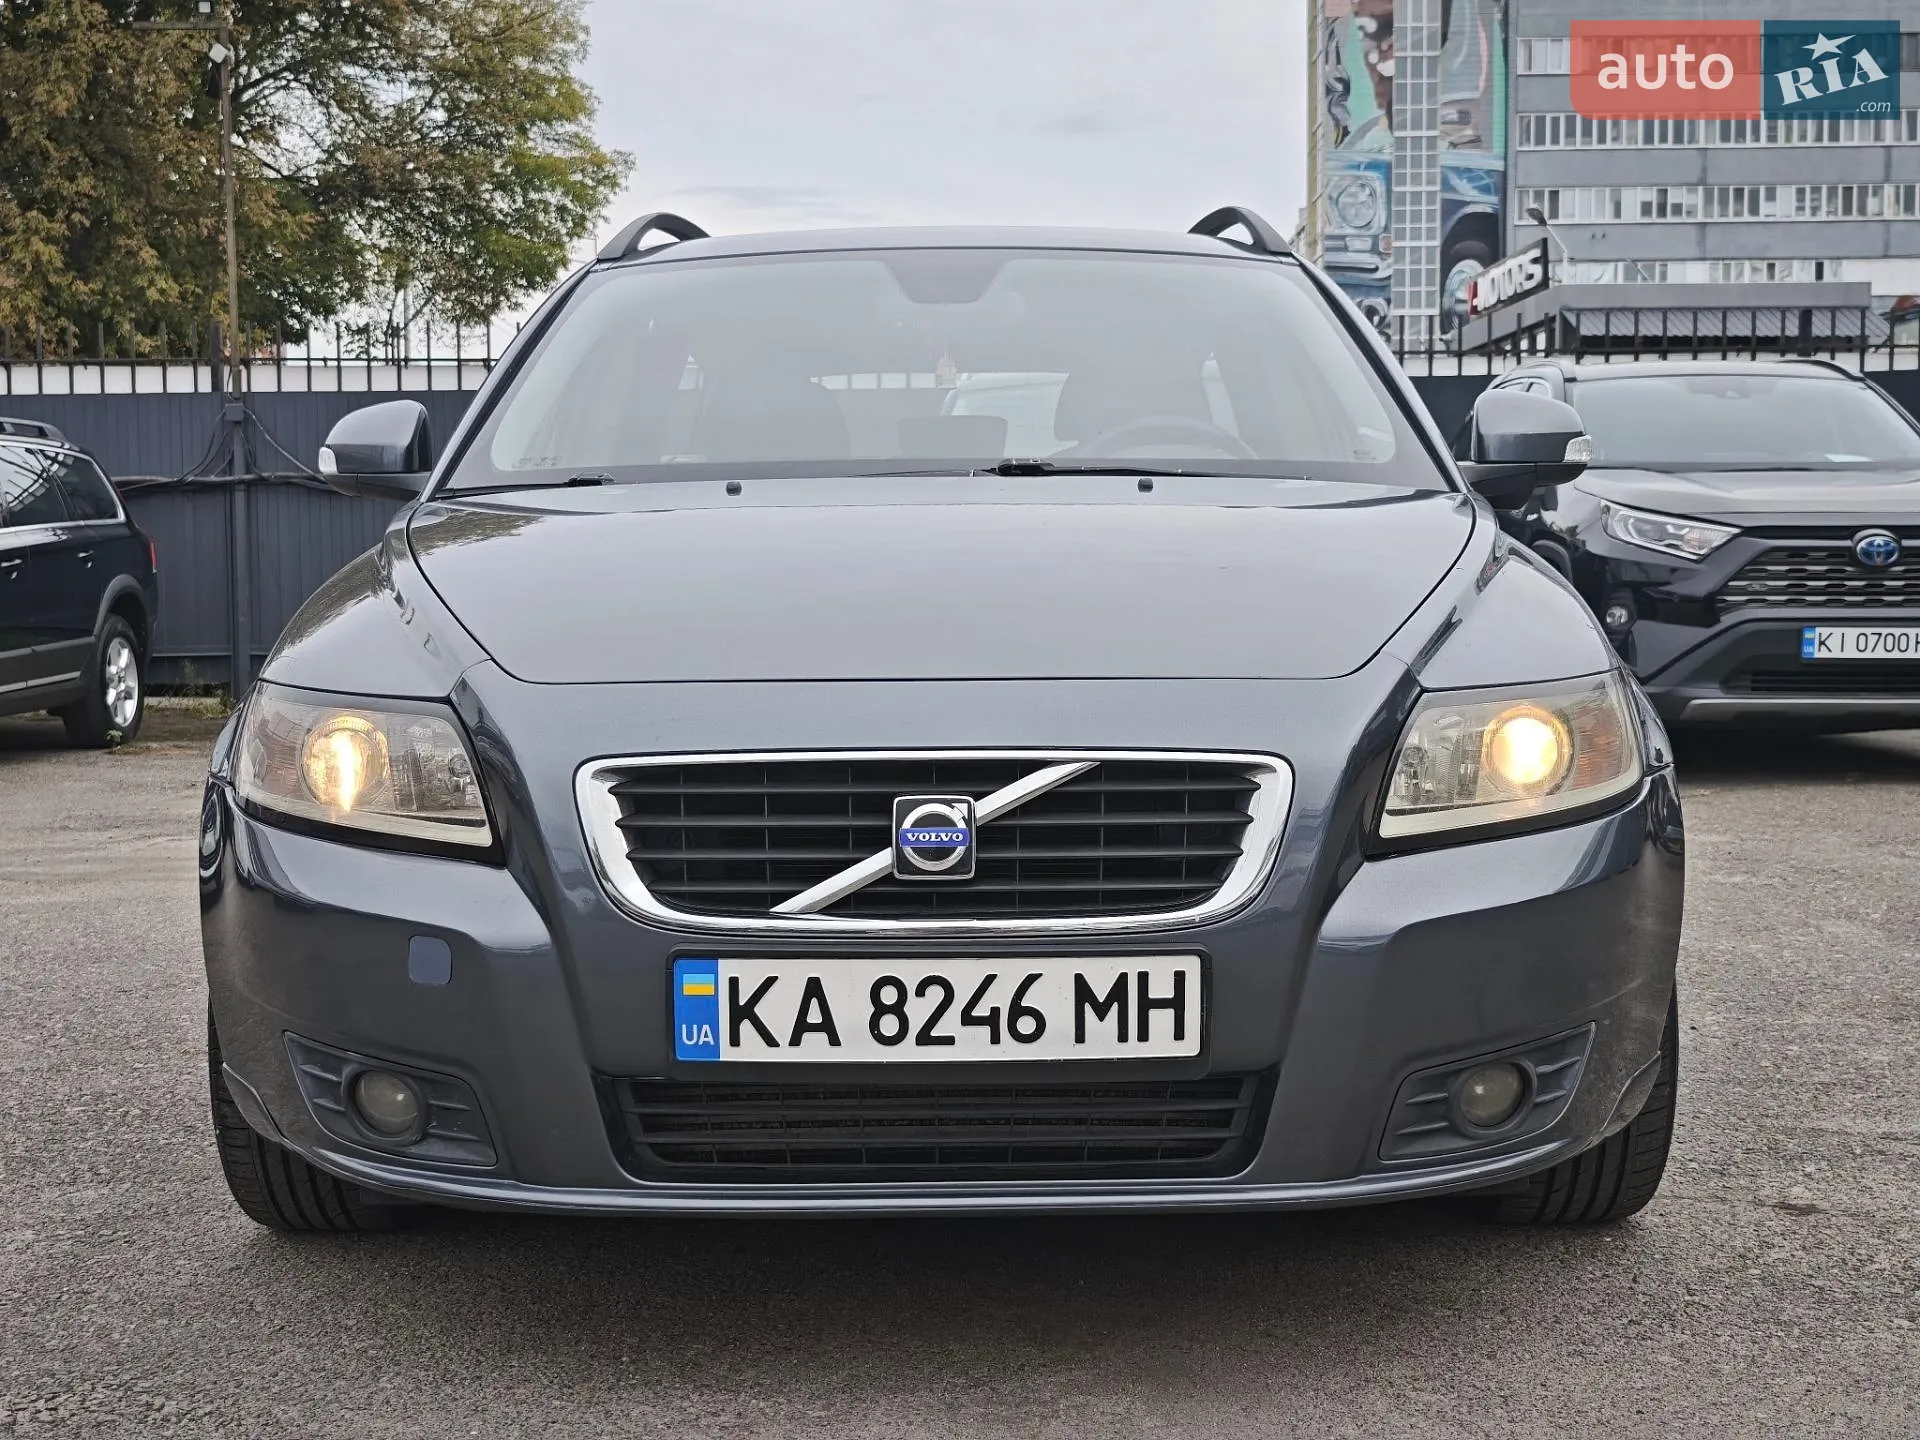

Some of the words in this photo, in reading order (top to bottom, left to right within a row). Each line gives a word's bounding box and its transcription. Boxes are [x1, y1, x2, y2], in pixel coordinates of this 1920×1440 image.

[1817, 632, 1846, 653] KI
[1856, 632, 1910, 653] 0700
[906, 832, 964, 842] VOLVO
[728, 975, 842, 1048] KA
[868, 974, 1047, 1047] 8246
[1073, 969, 1186, 1044] MH
[682, 1024, 714, 1045] UA
